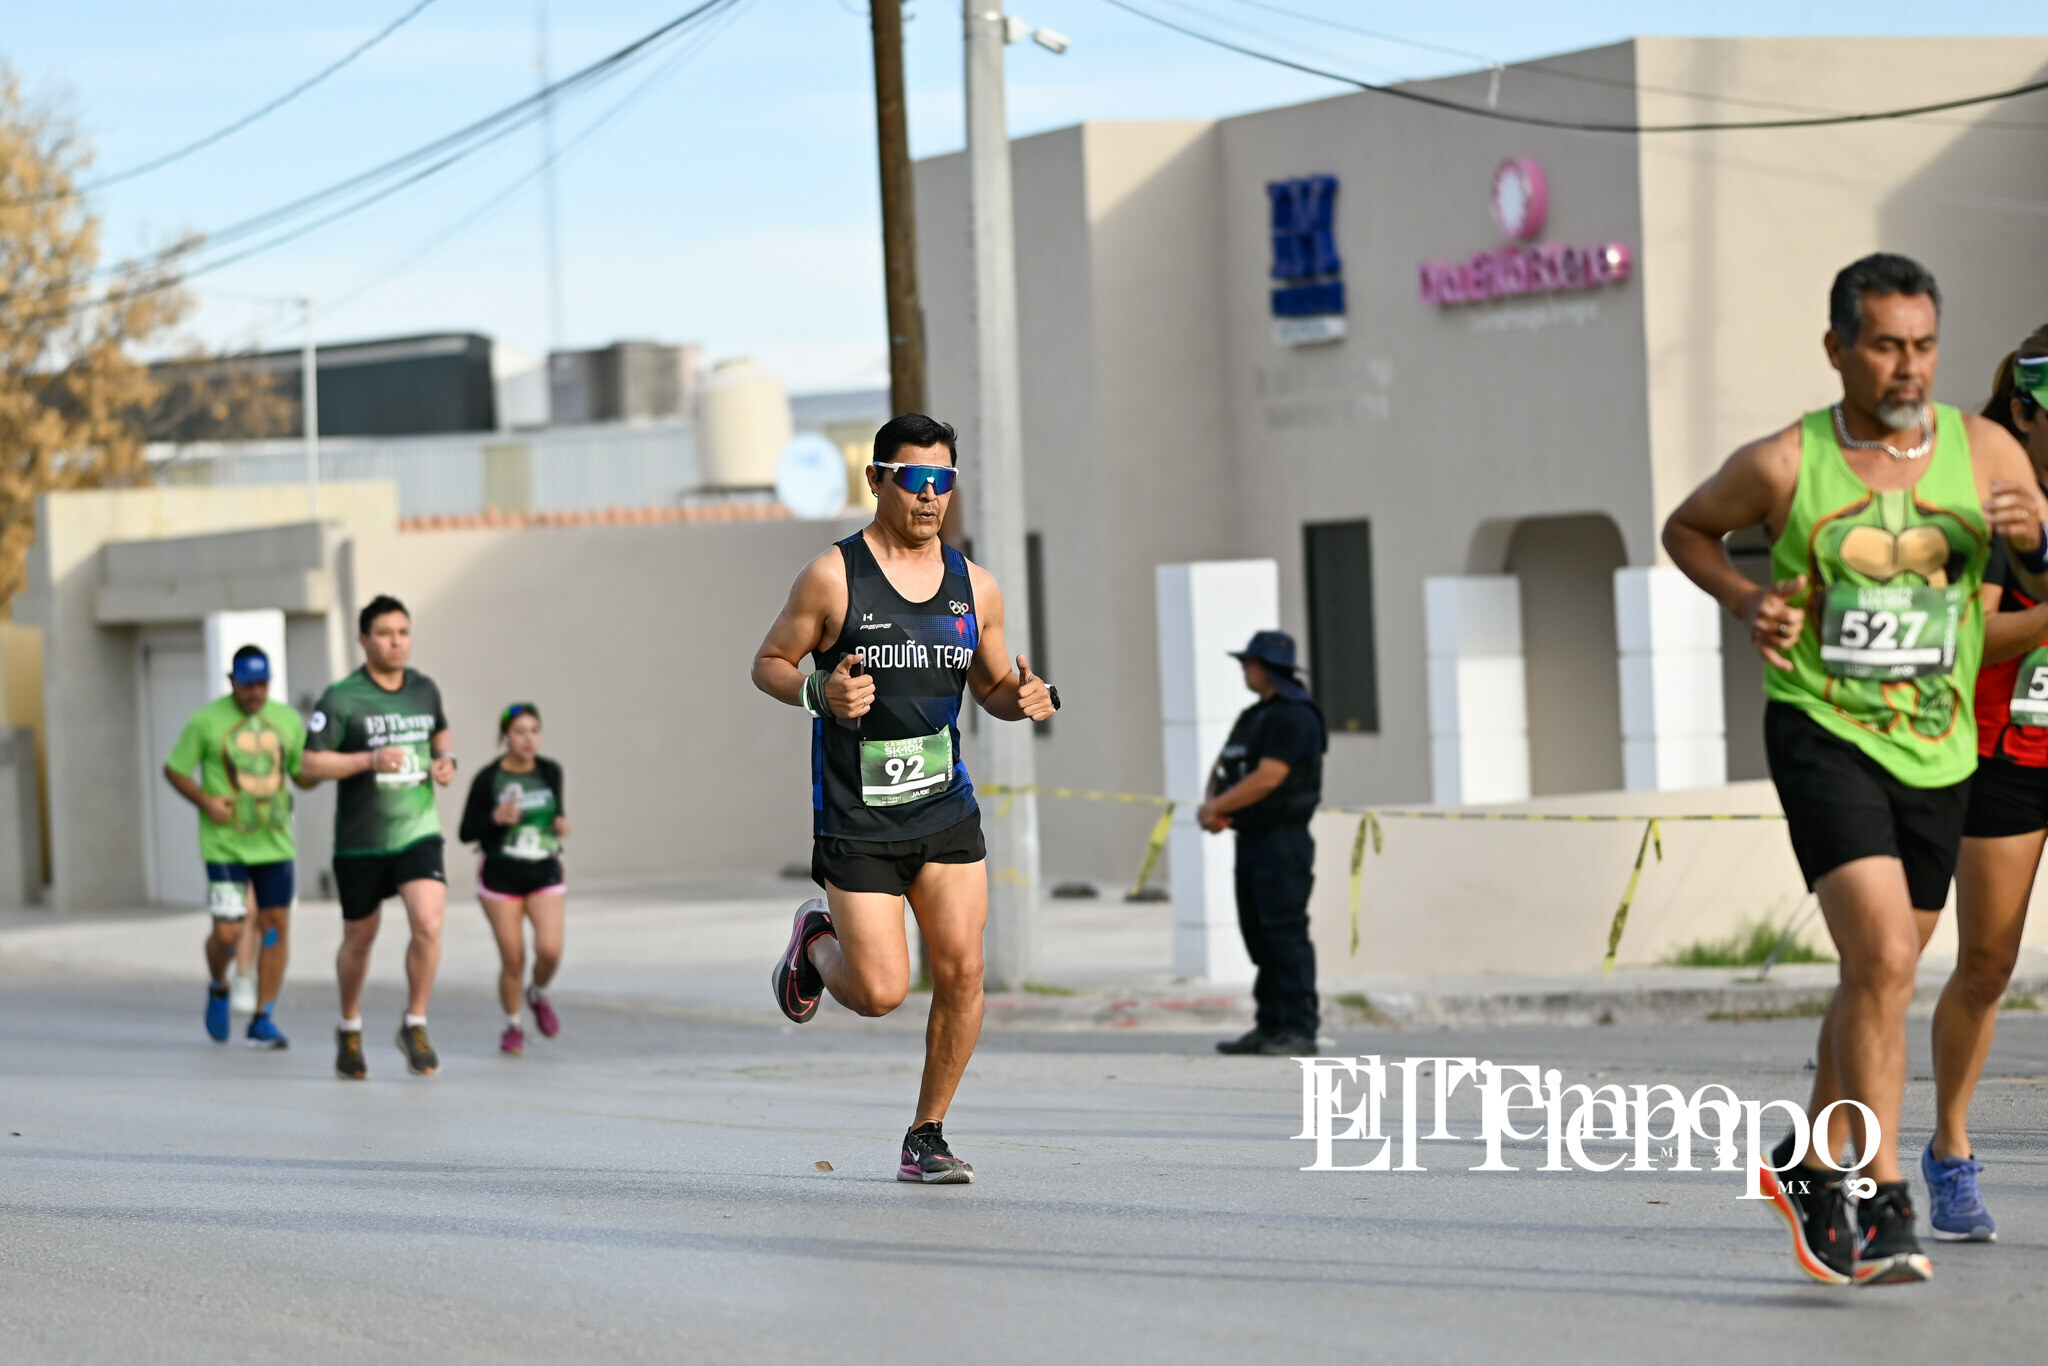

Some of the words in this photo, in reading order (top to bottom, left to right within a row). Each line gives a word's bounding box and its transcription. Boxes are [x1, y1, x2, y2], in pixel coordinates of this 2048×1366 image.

[860, 623, 892, 631] PEPE
[1839, 610, 1928, 649] 527
[934, 644, 973, 671] TEAM
[2028, 665, 2048, 699] 5
[885, 743, 924, 755] 5K-10K
[885, 755, 925, 784] 92
